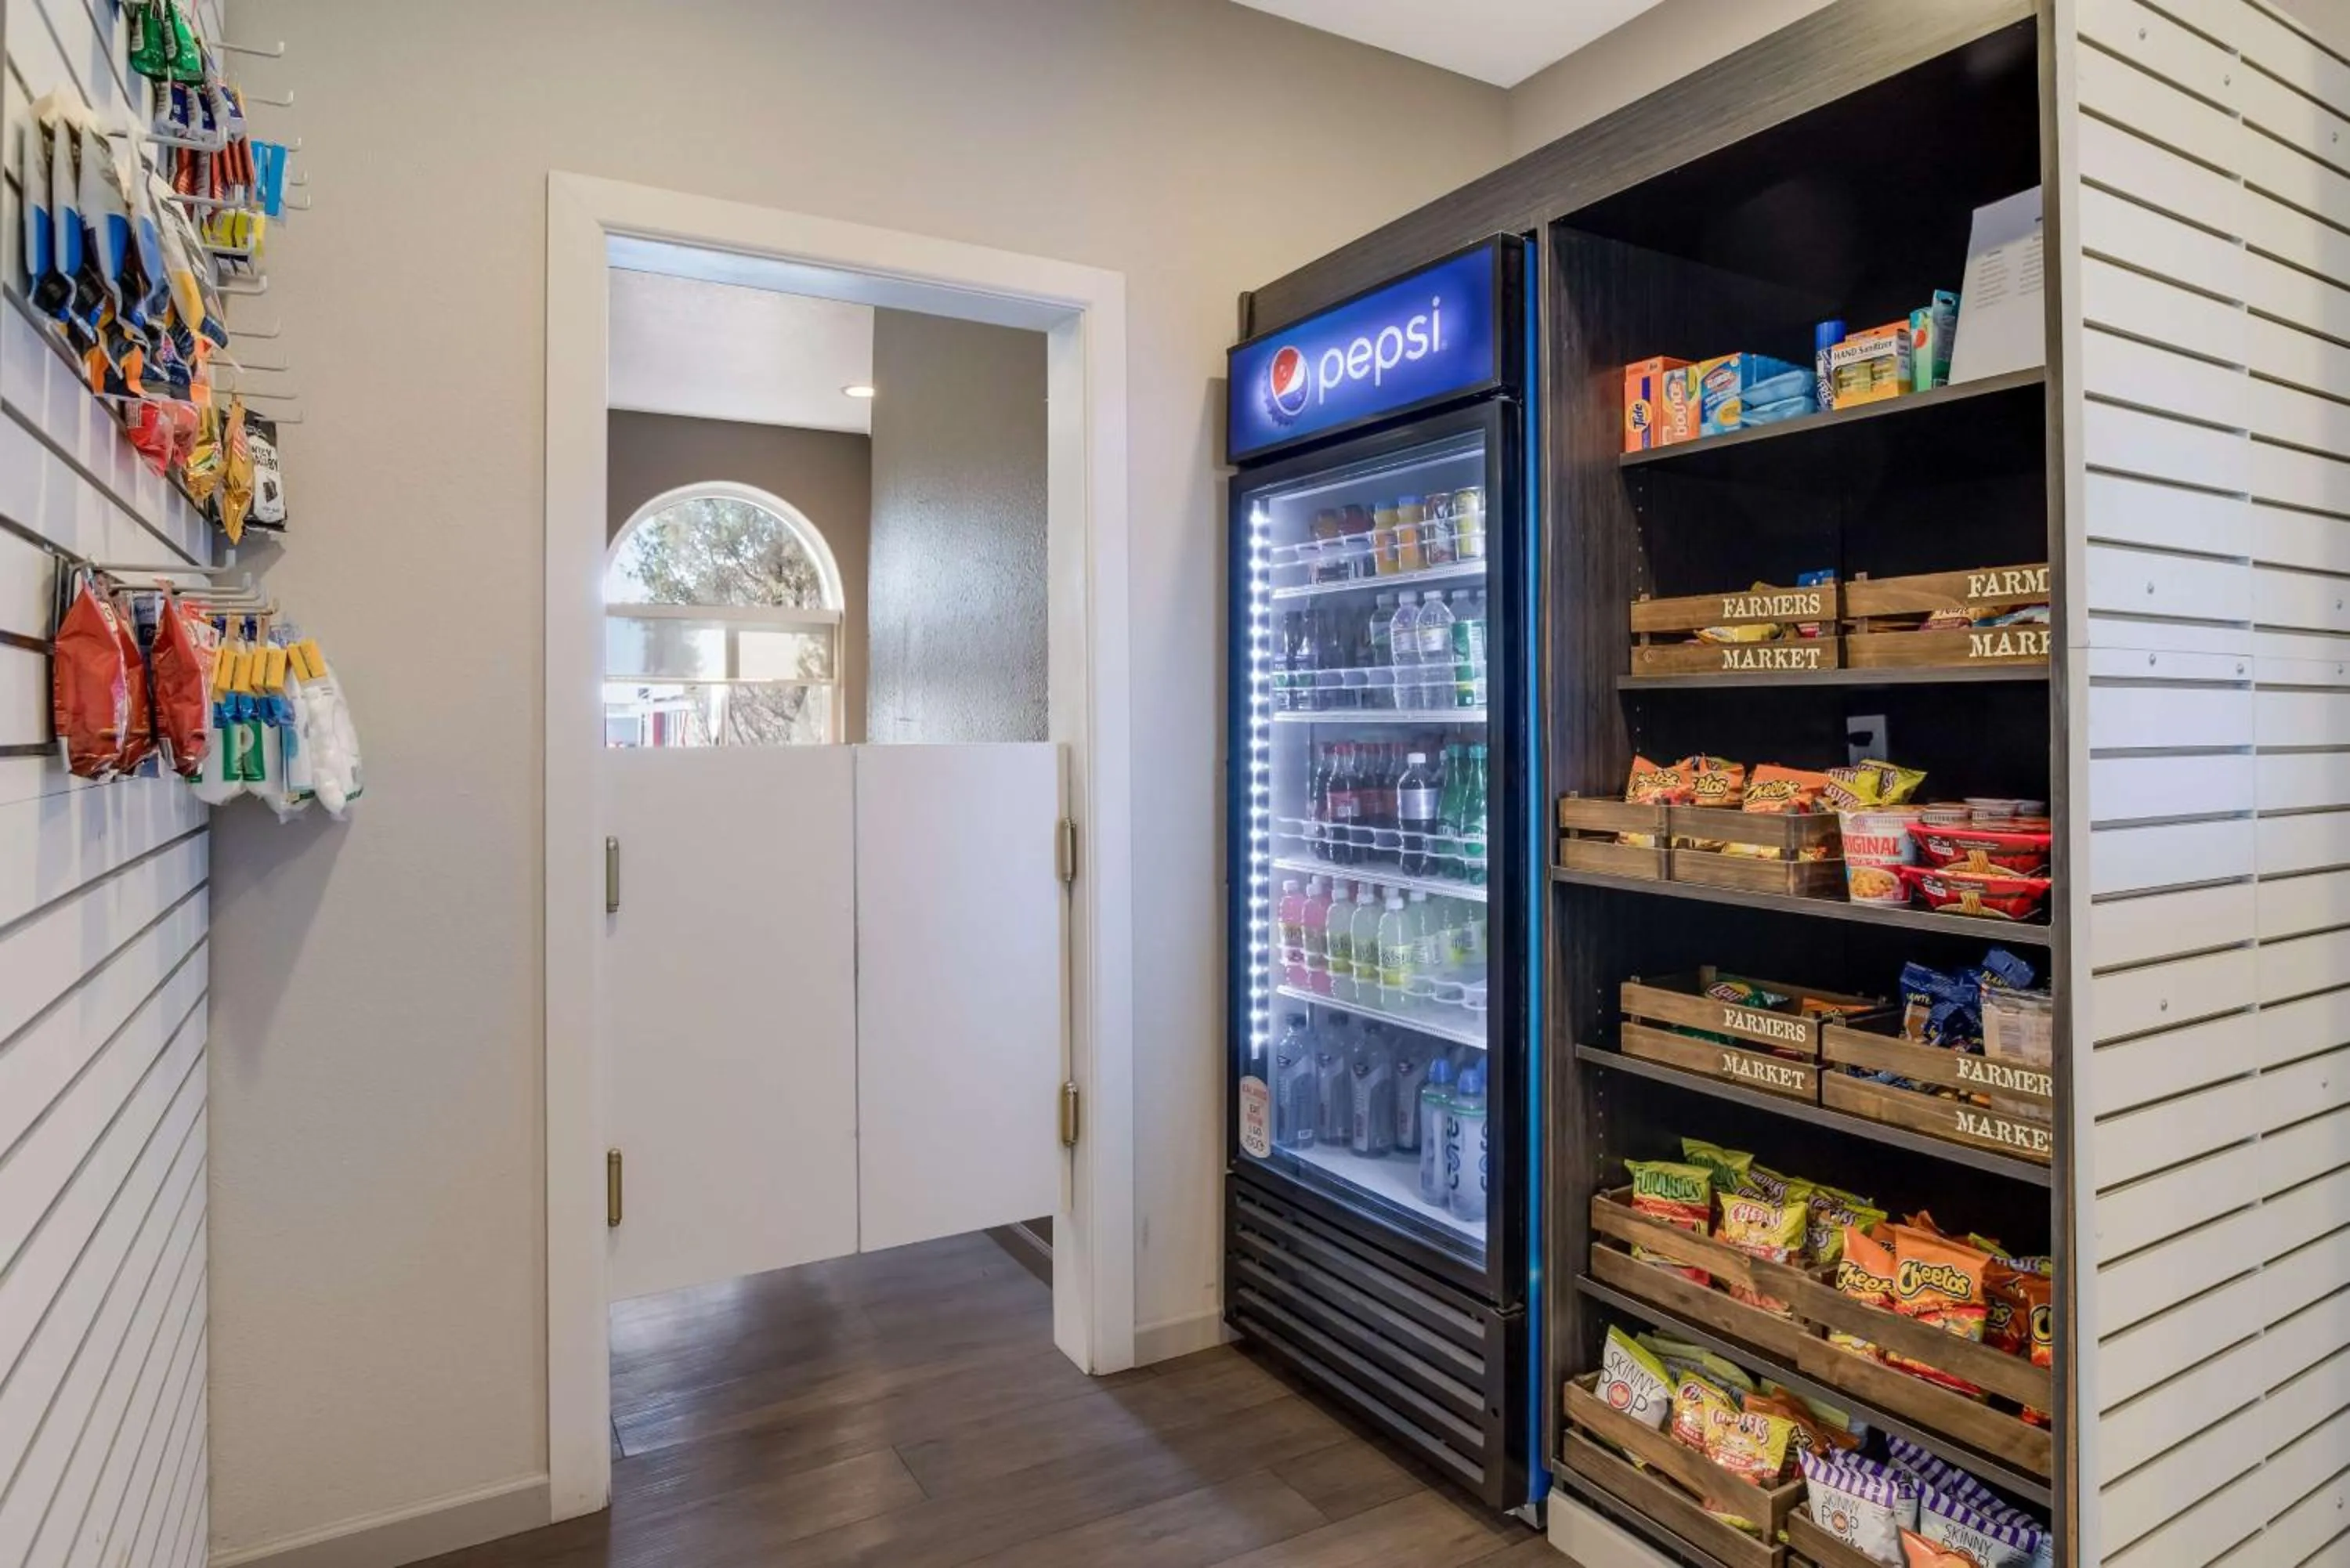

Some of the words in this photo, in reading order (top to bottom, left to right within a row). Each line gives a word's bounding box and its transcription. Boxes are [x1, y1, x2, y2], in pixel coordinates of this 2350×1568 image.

[1318, 295, 1441, 405] pepsi
[1834, 348, 1857, 360] HAND
[1633, 403, 1647, 429] Tide
[1723, 594, 1820, 619] FARMERS
[1722, 648, 1820, 670] MARKET
[1723, 1008, 1806, 1042] FARMERS
[1723, 1053, 1806, 1089] MARKET
[1957, 1057, 2052, 1096] FARMER
[1956, 1111, 2052, 1152] MARKE
[1899, 1261, 1971, 1296] Cheetos
[1607, 1352, 1661, 1396] SKINNY
[1823, 1490, 1860, 1516] SKINNY
[1821, 1505, 1859, 1537] POP
[1944, 1523, 1994, 1555] SKINNY
